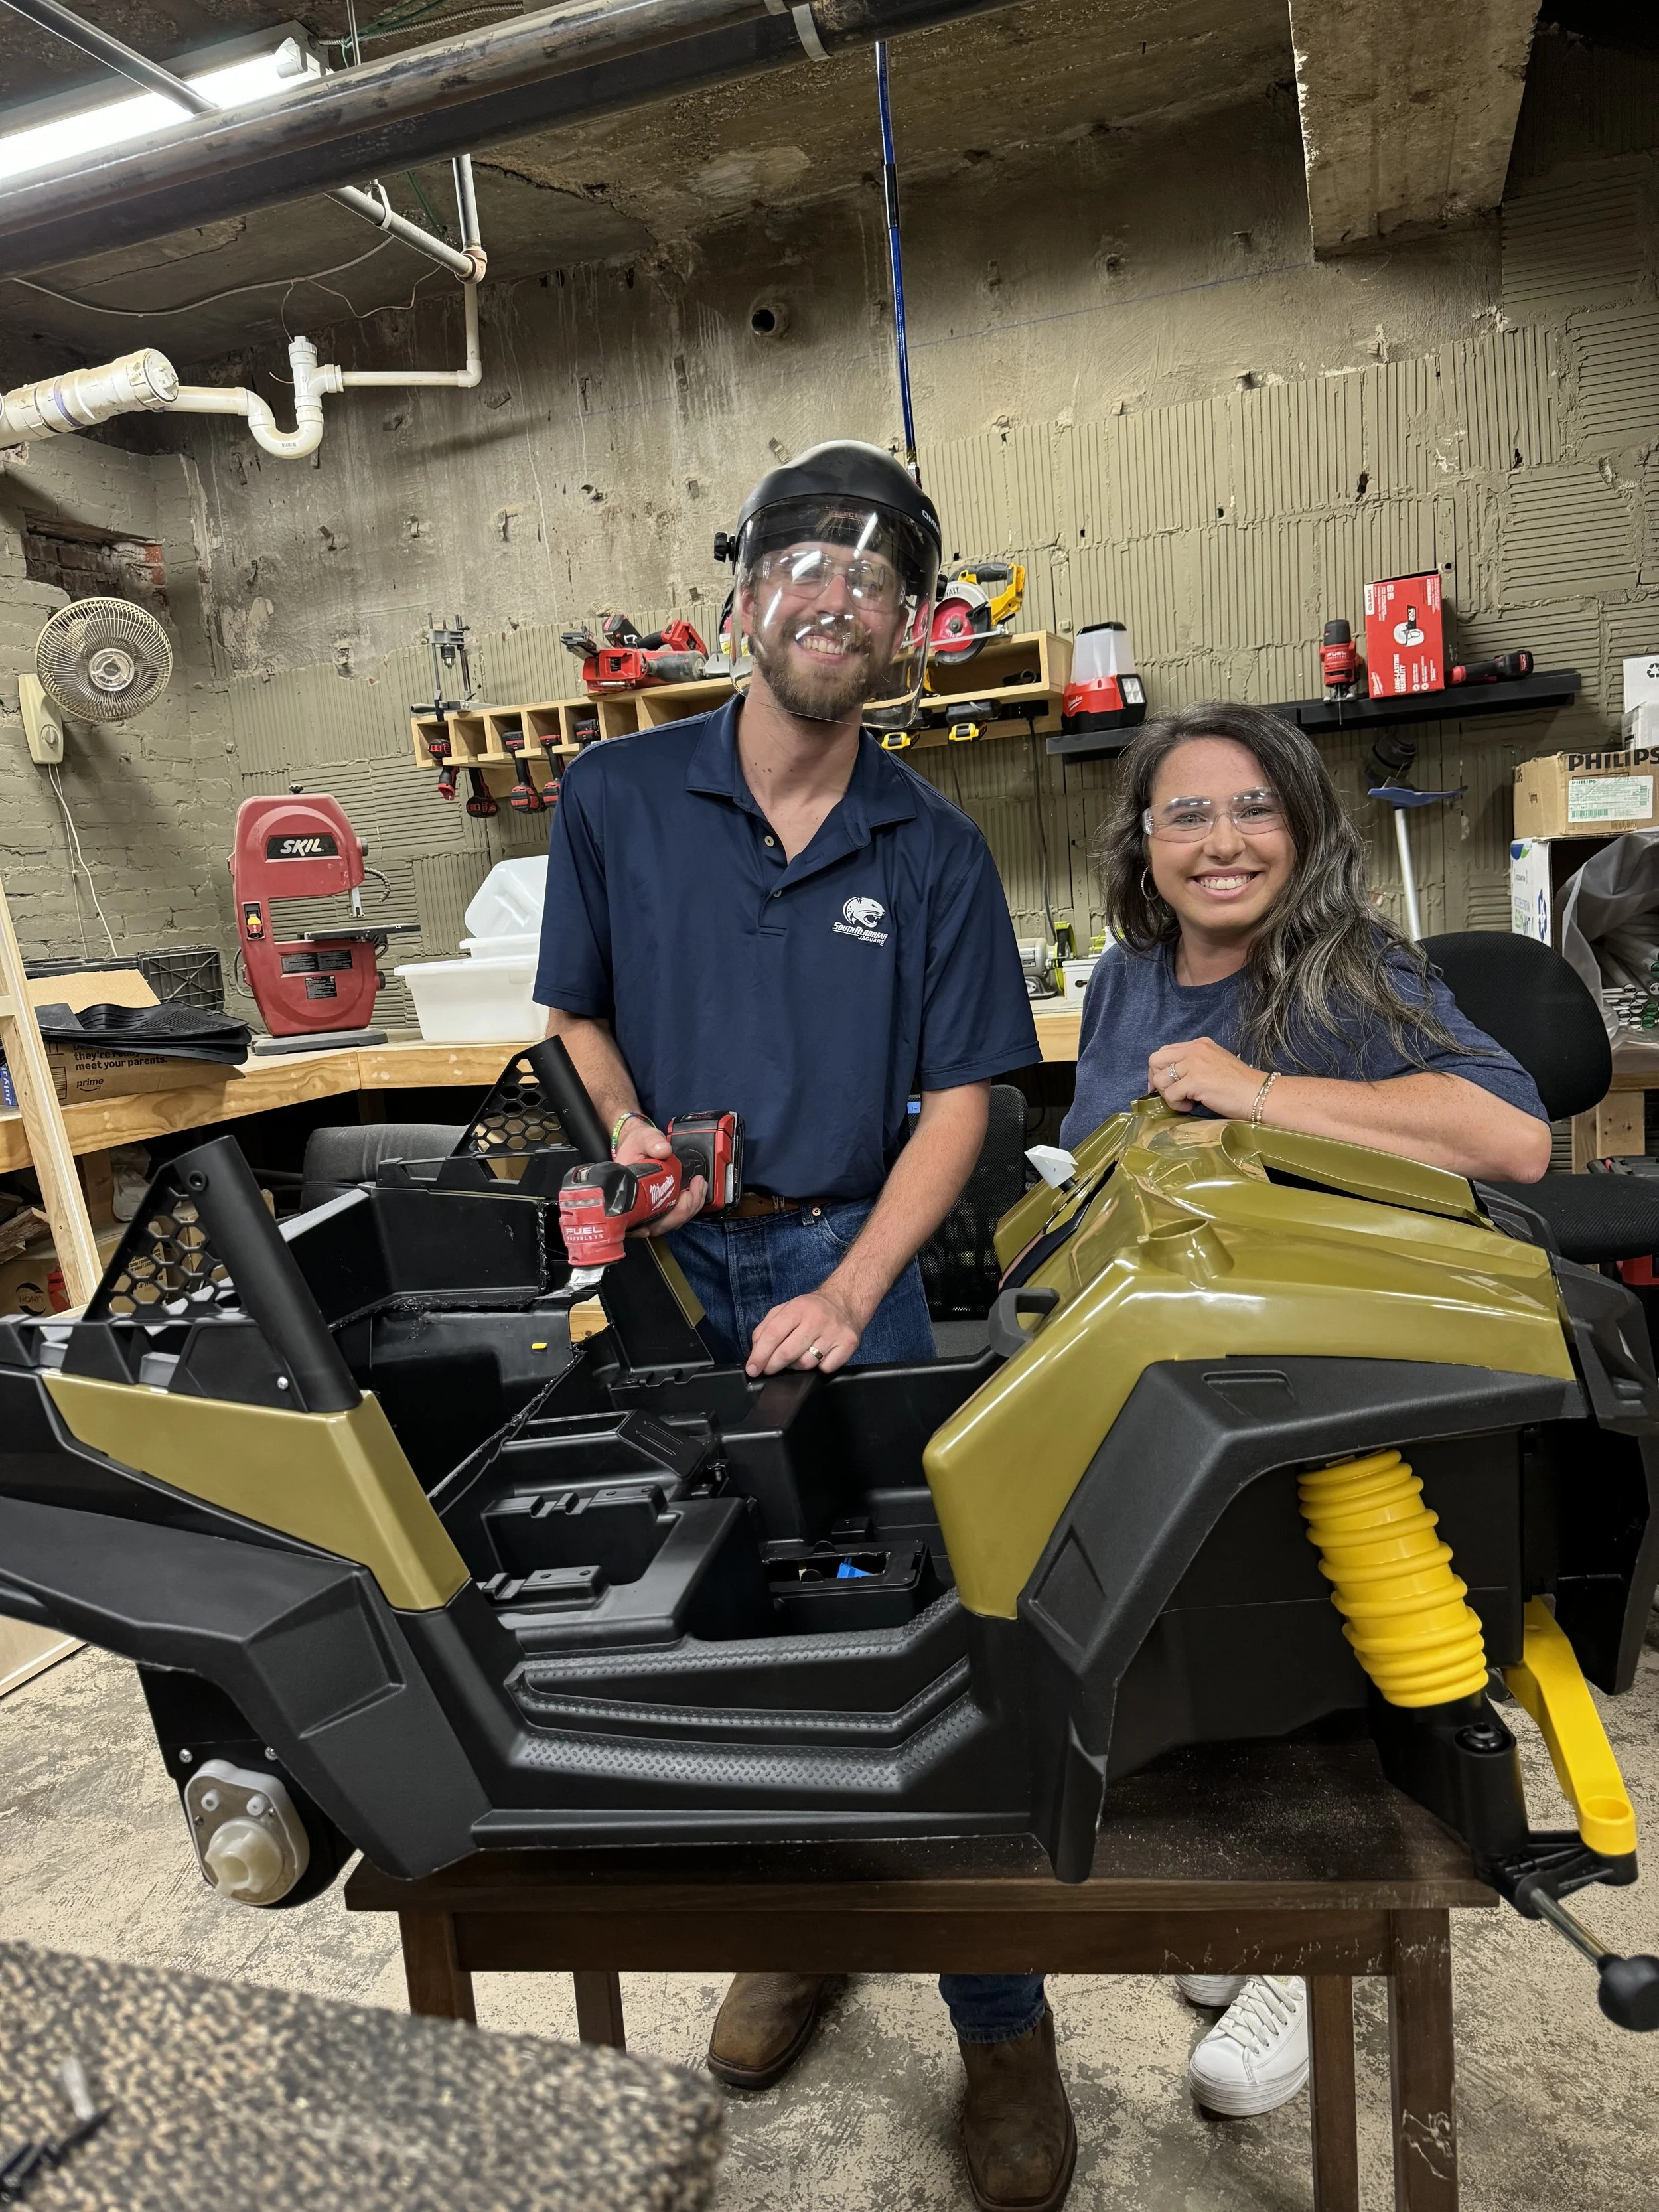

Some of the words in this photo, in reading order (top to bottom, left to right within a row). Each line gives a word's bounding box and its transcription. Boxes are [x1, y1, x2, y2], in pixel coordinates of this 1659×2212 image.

[1568, 747, 1659, 771] PHILIPS
[280, 838, 322, 857] SKIL
[857, 935, 885, 944] JAGUARS
[74, 1051, 110, 1061] they're
[75, 1062, 102, 1070] meet
[103, 1060, 127, 1070] your
[127, 1055, 168, 1067] parents.
[76, 1078, 104, 1088] prime
[650, 1175, 675, 1205] Milwaukee
[566, 1226, 603, 1235] FUEL
